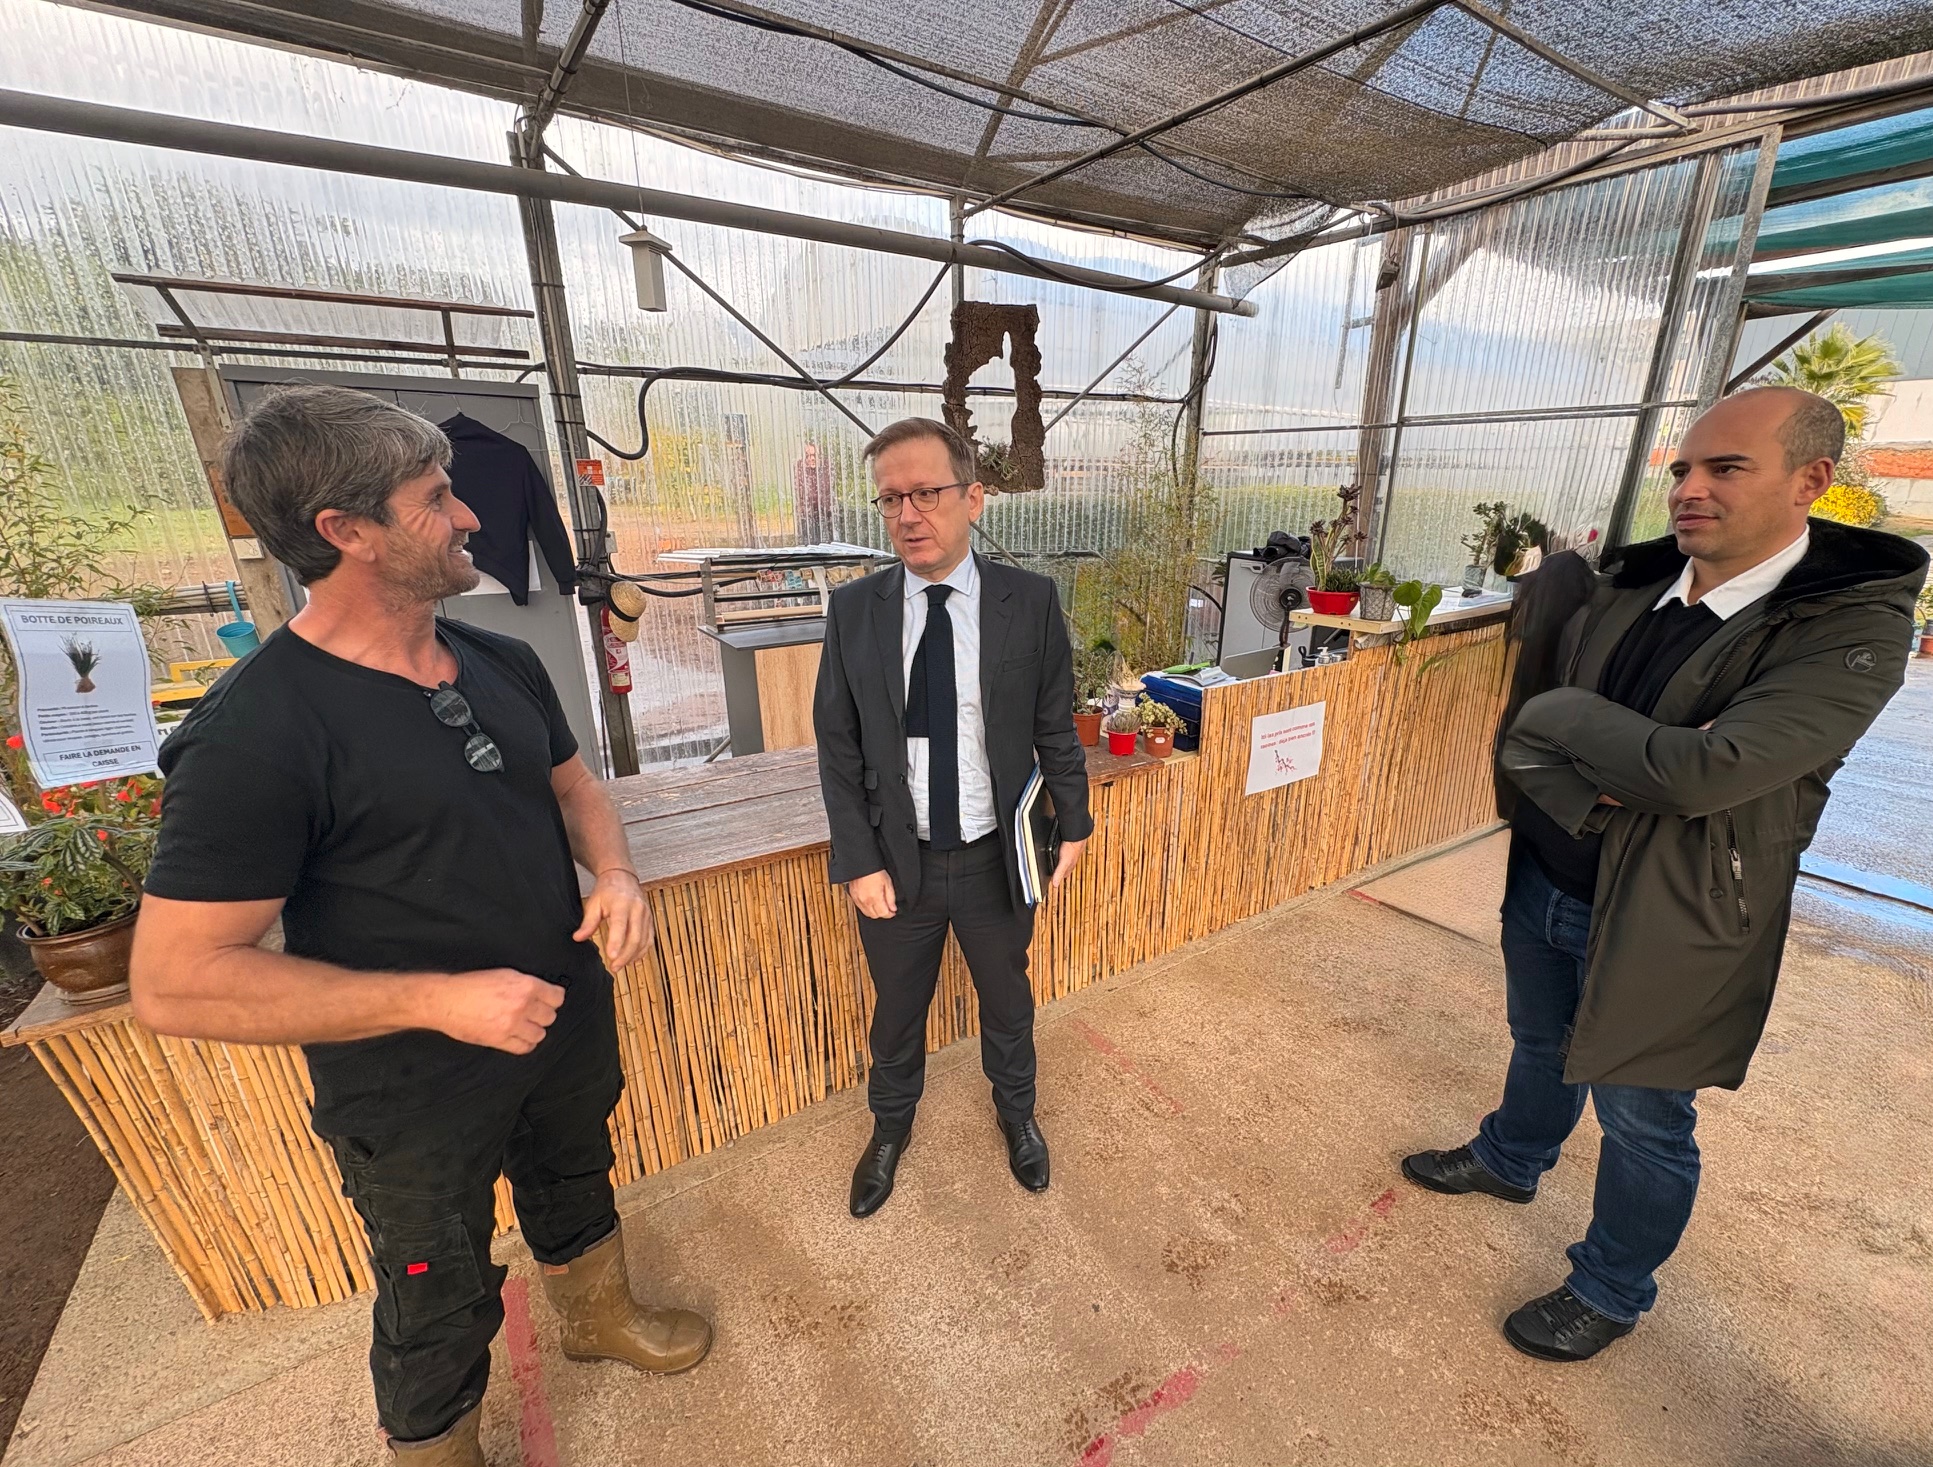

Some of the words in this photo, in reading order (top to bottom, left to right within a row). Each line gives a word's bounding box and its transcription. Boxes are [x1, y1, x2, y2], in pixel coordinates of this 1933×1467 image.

[20, 615, 56, 624] BOTTE
[58, 616, 72, 624] DE
[74, 616, 124, 625] POIREAUX
[59, 752, 82, 761] FAIRE
[94, 746, 130, 757] DEMANDE
[92, 758, 119, 767] CAISSE
